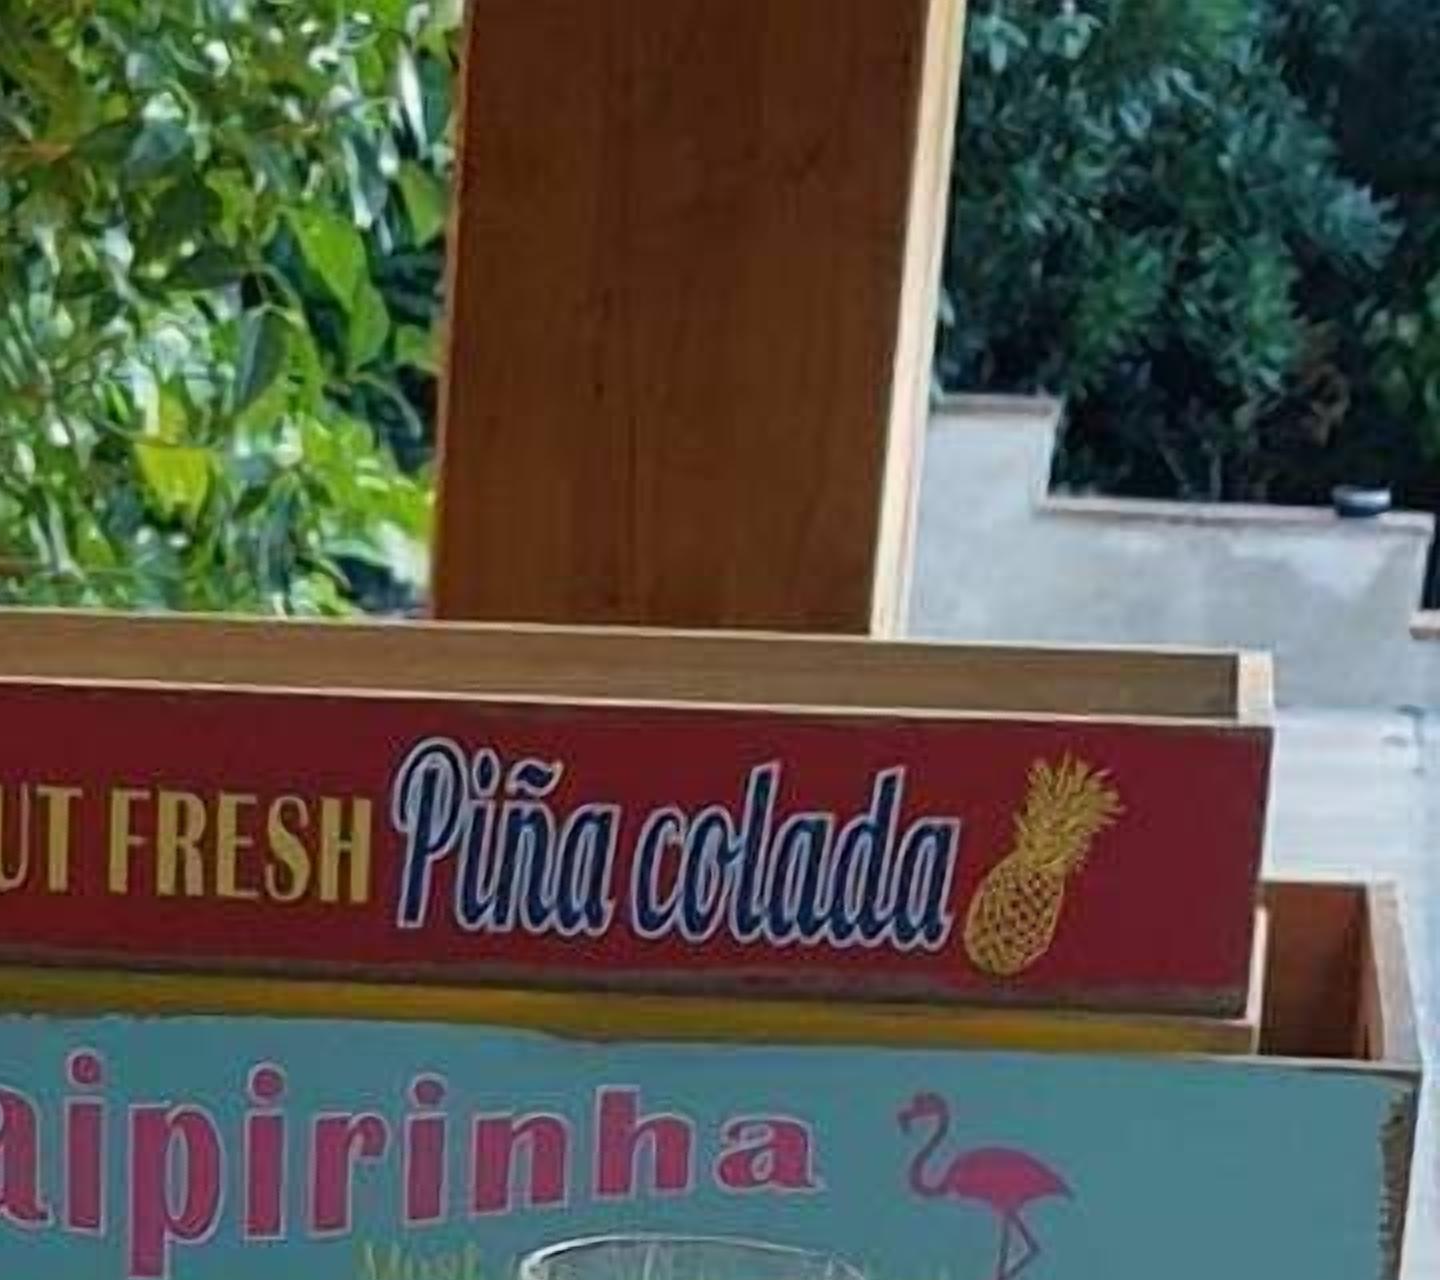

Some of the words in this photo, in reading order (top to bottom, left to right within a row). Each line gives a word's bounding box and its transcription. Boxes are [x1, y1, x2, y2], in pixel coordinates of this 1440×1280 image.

[108, 789, 372, 904] FRESH
[392, 736, 620, 938] Piña
[632, 760, 962, 955] colada
